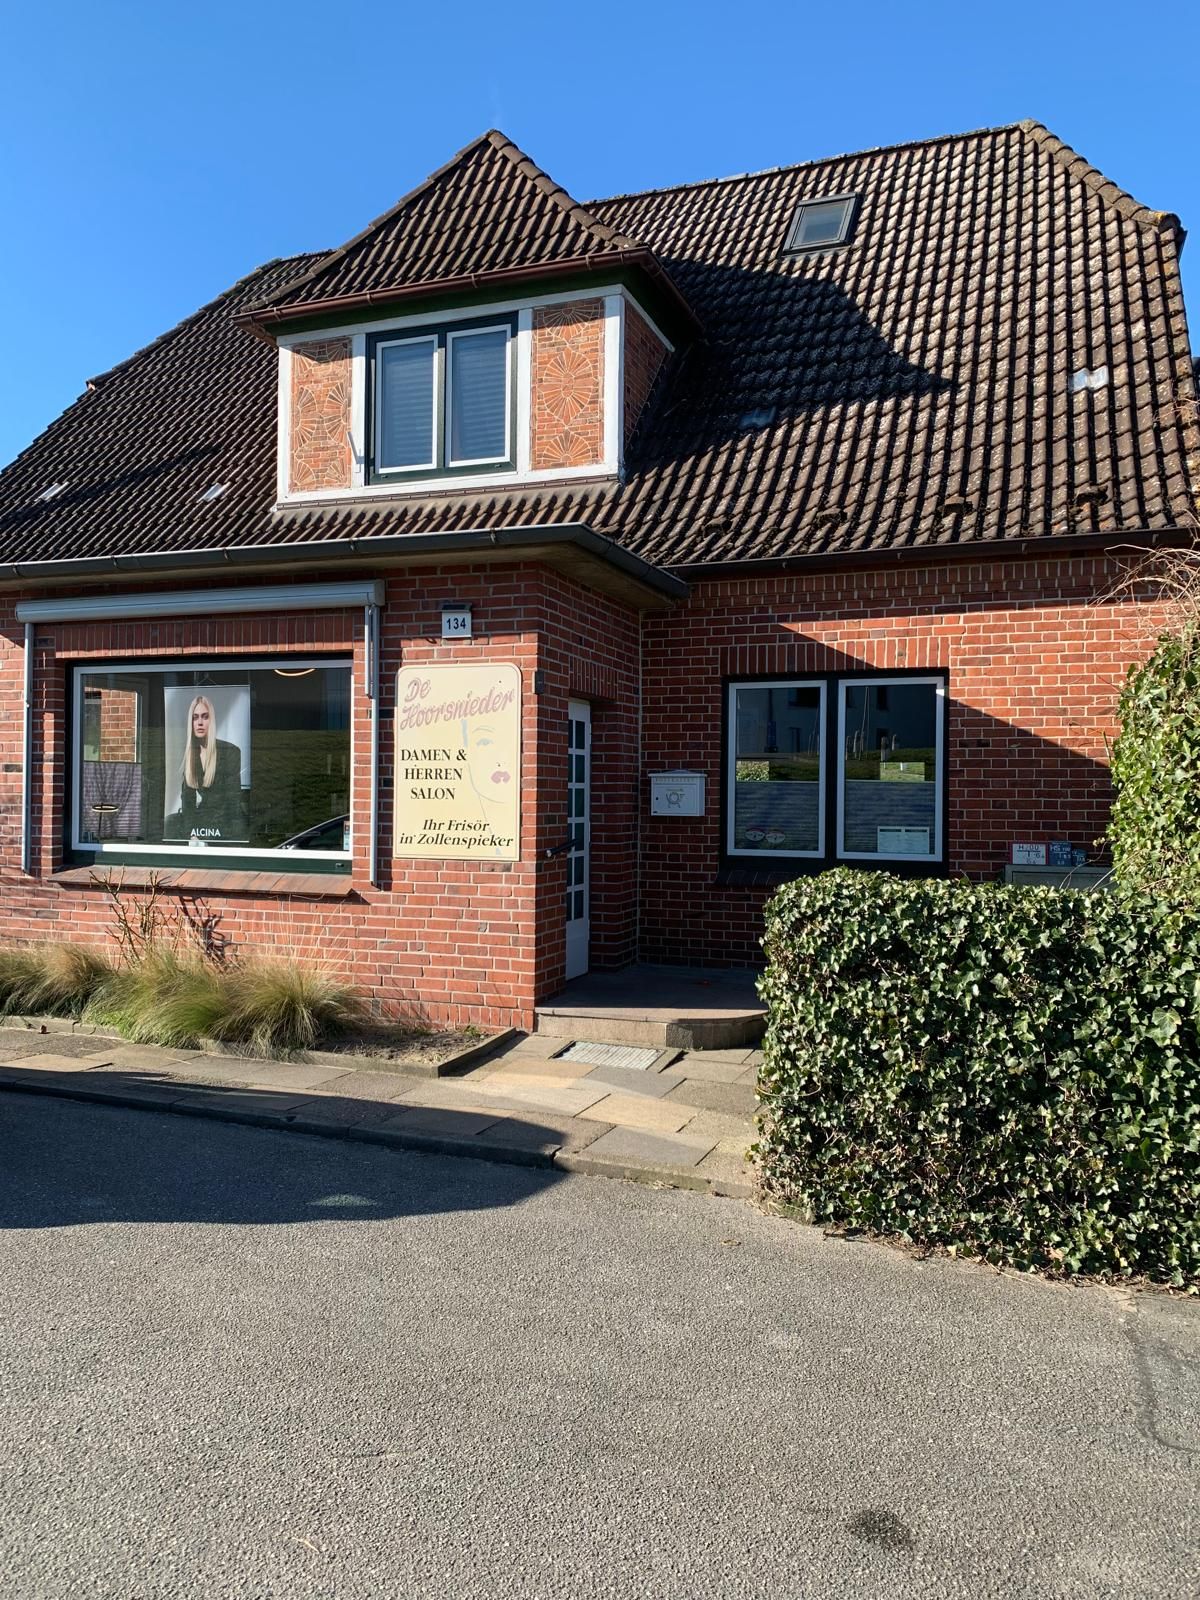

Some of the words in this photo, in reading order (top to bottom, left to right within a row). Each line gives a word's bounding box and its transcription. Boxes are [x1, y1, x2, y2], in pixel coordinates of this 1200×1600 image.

[446, 617, 467, 630] 134
[404, 678, 432, 703] De
[400, 687, 515, 730] Hoorsnieder
[400, 749, 451, 761] DAMEN
[456, 749, 467, 761] &
[404, 768, 463, 780] HERREN
[410, 787, 456, 800] SALON
[422, 819, 445, 831] Ihr
[447, 819, 490, 832] Frisör
[190, 828, 221, 837] ALCINA
[399, 833, 413, 845] in
[416, 833, 514, 849] Zollenspieker
